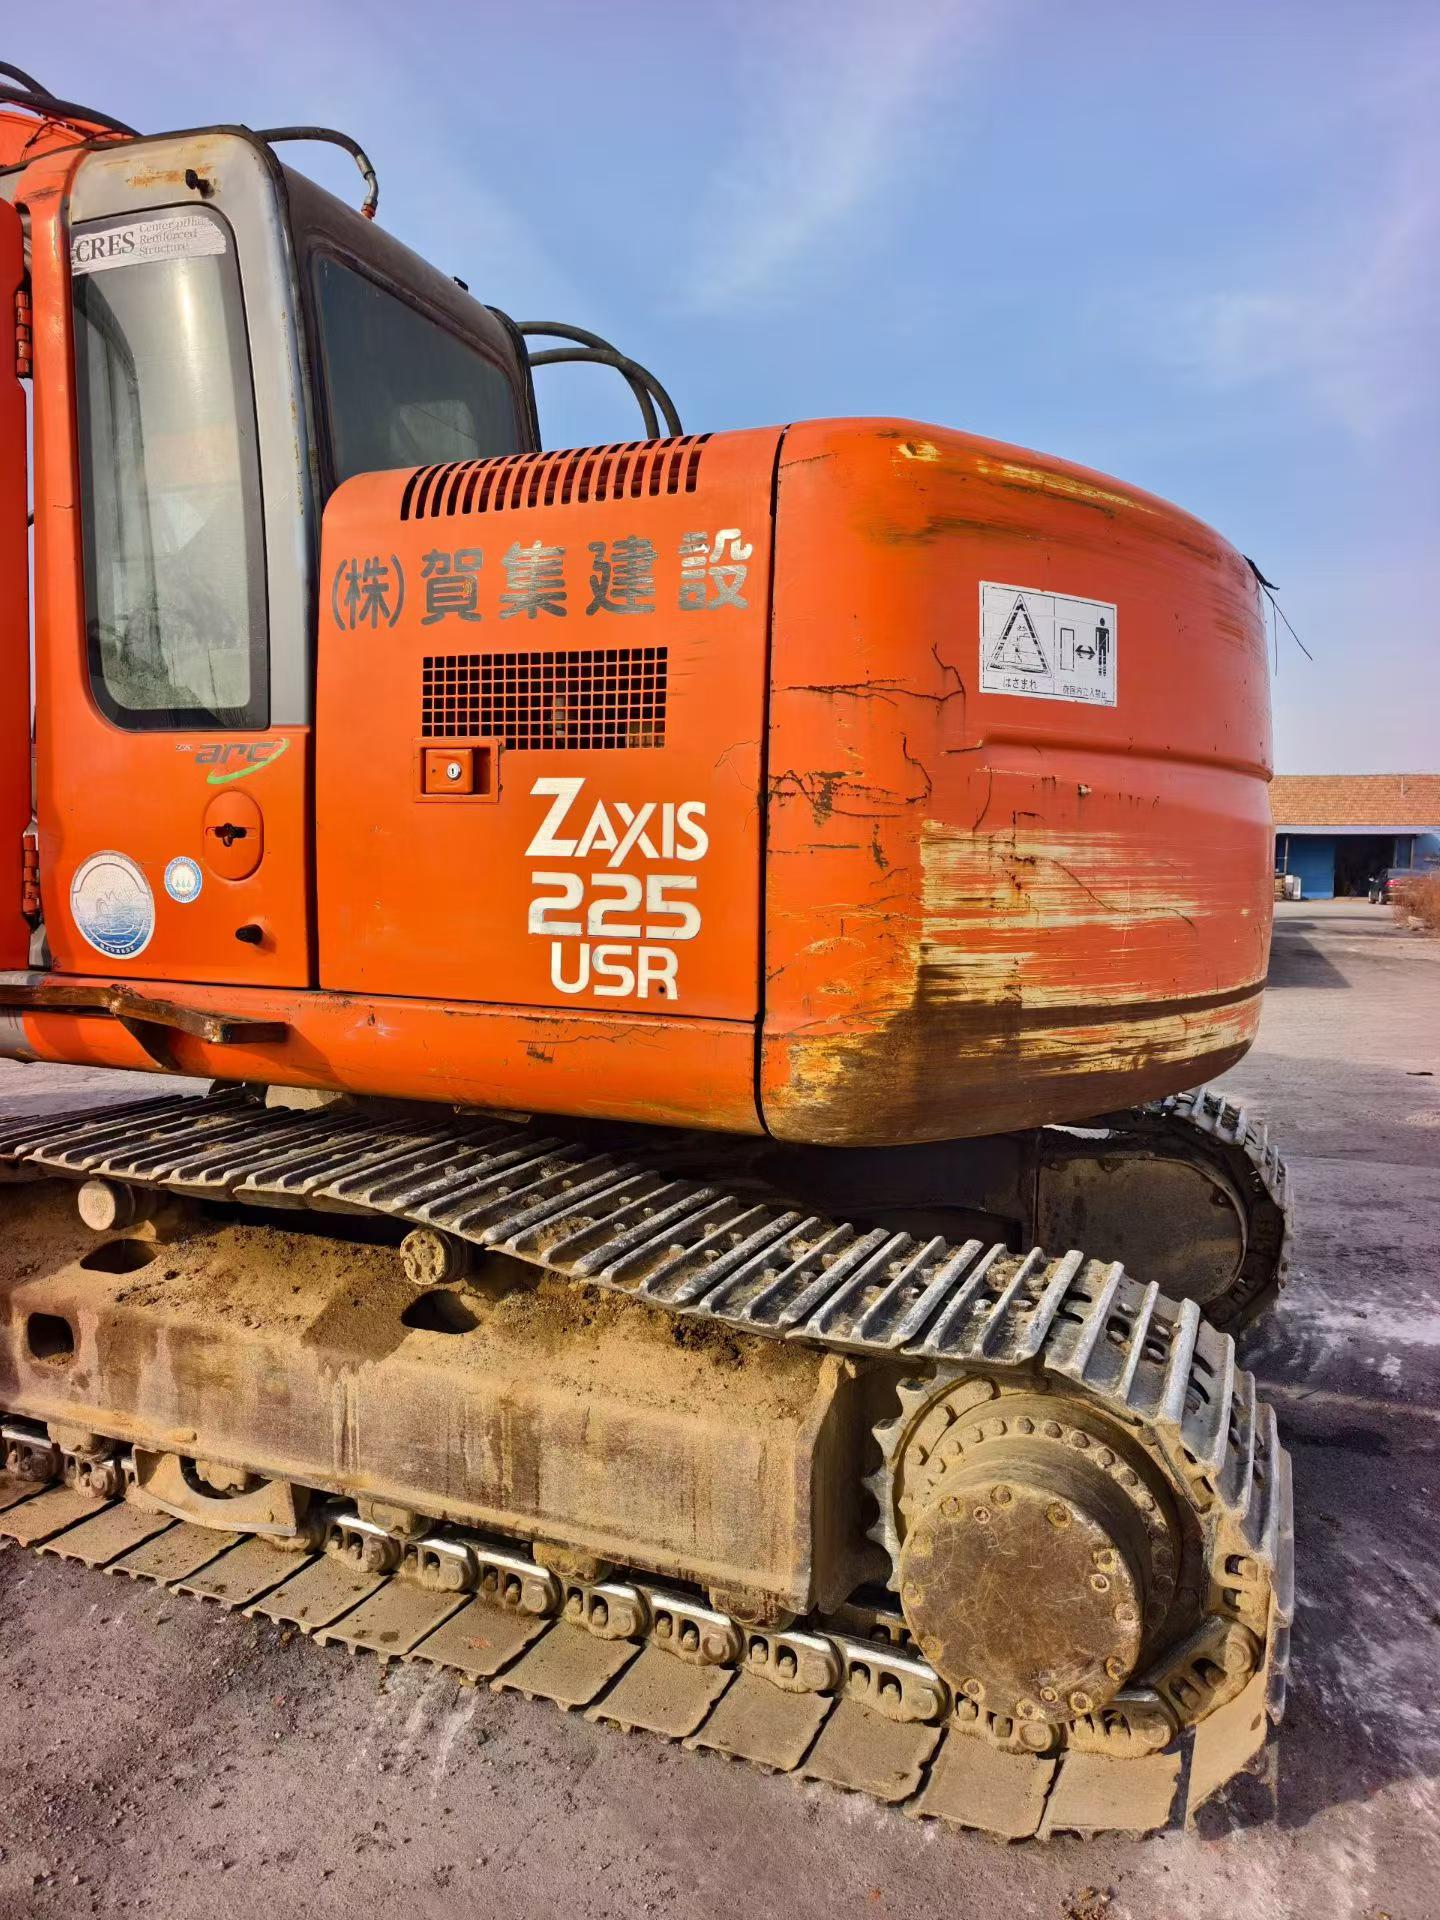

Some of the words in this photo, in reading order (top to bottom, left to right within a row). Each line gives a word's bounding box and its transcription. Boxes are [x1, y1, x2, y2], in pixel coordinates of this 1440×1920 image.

[75, 231, 135, 262] CRES
[139, 229, 198, 244] Reinforced
[1003, 676, 1039, 690] はさまれ
[195, 742, 277, 765] arc
[524, 777, 709, 868] ZAXIS
[528, 871, 702, 940] 225
[551, 942, 679, 1000] USR
